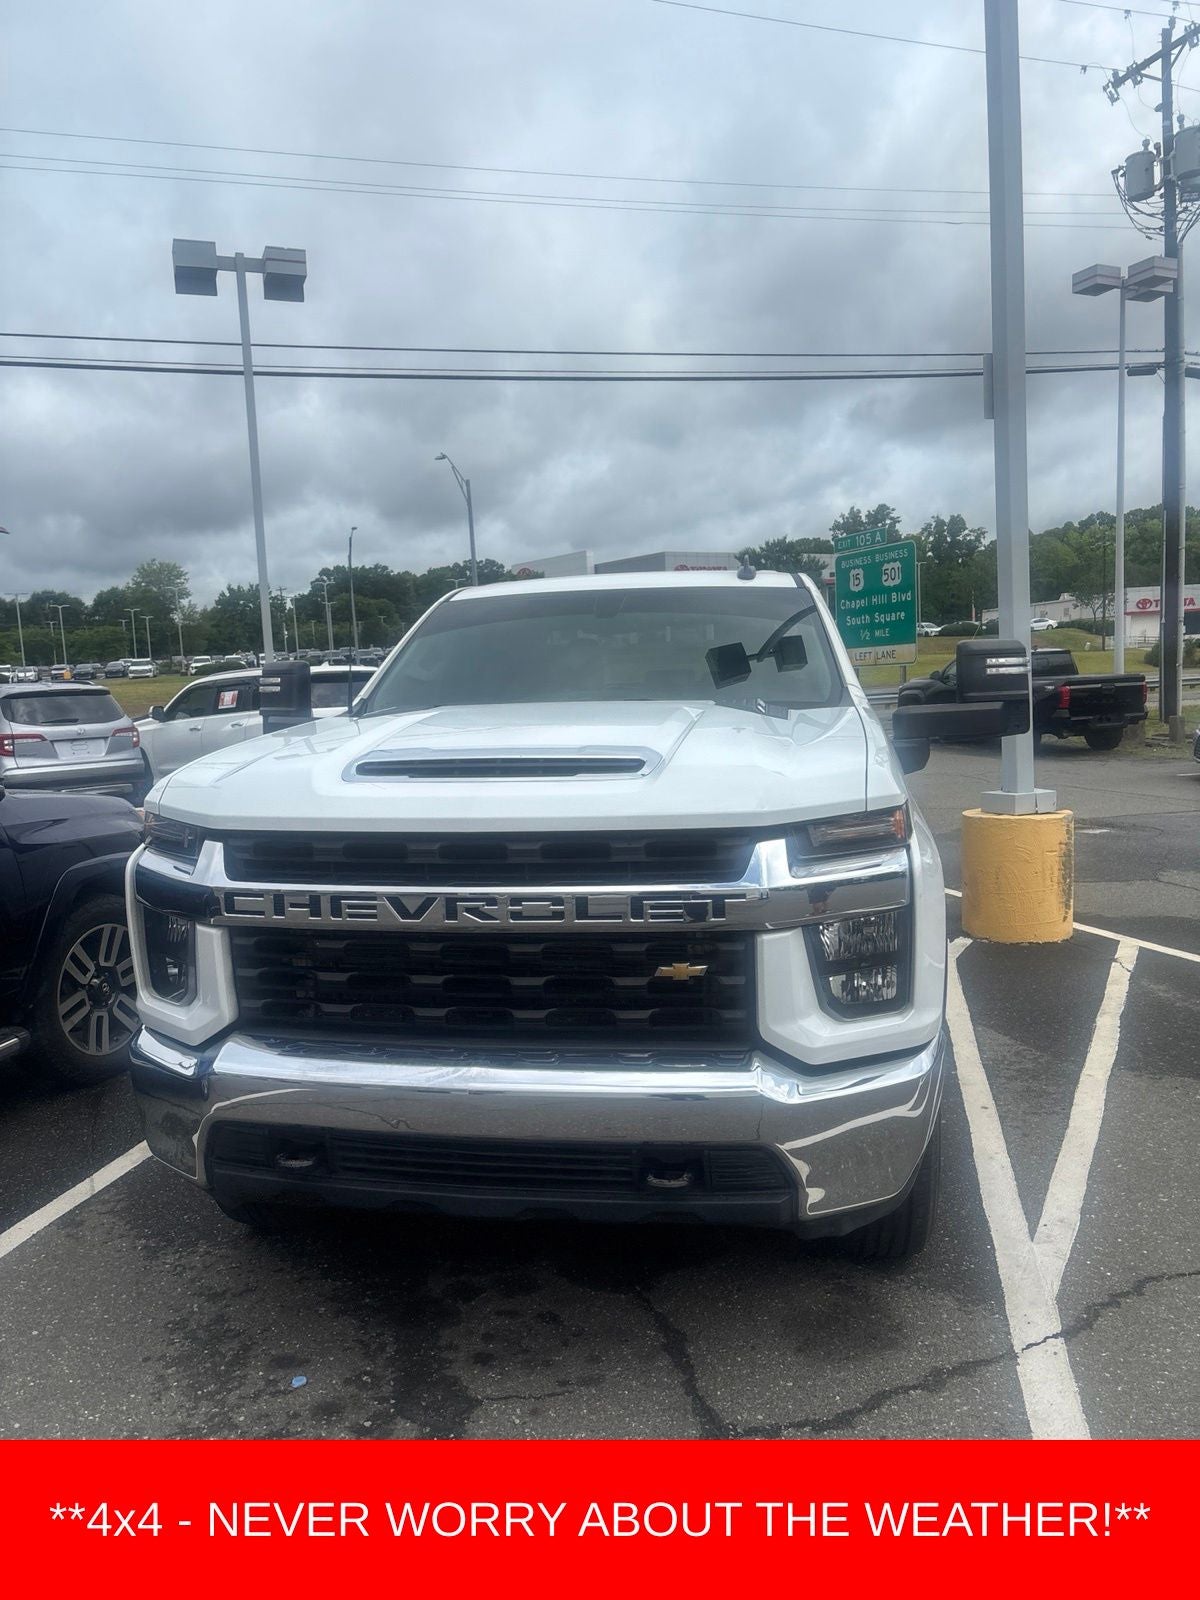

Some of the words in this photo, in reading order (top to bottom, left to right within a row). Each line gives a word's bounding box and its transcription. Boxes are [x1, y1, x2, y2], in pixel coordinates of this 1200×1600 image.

[838, 539, 851, 549] EXIT
[855, 533, 872, 547] 105
[875, 532, 882, 543] A
[841, 557, 872, 569] BUSINESS
[875, 549, 909, 562] BUSINESS
[852, 572, 861, 587] 15
[883, 567, 900, 583] 501
[840, 596, 868, 610] Chapel
[872, 593, 888, 605] Hill
[891, 590, 912, 602] Blvd
[846, 613, 871, 626] South
[874, 611, 906, 625] Square
[874, 628, 890, 637] MILE
[854, 651, 873, 661] LEFT
[876, 650, 897, 661] LANE
[224, 892, 747, 922] CHEVROLET
